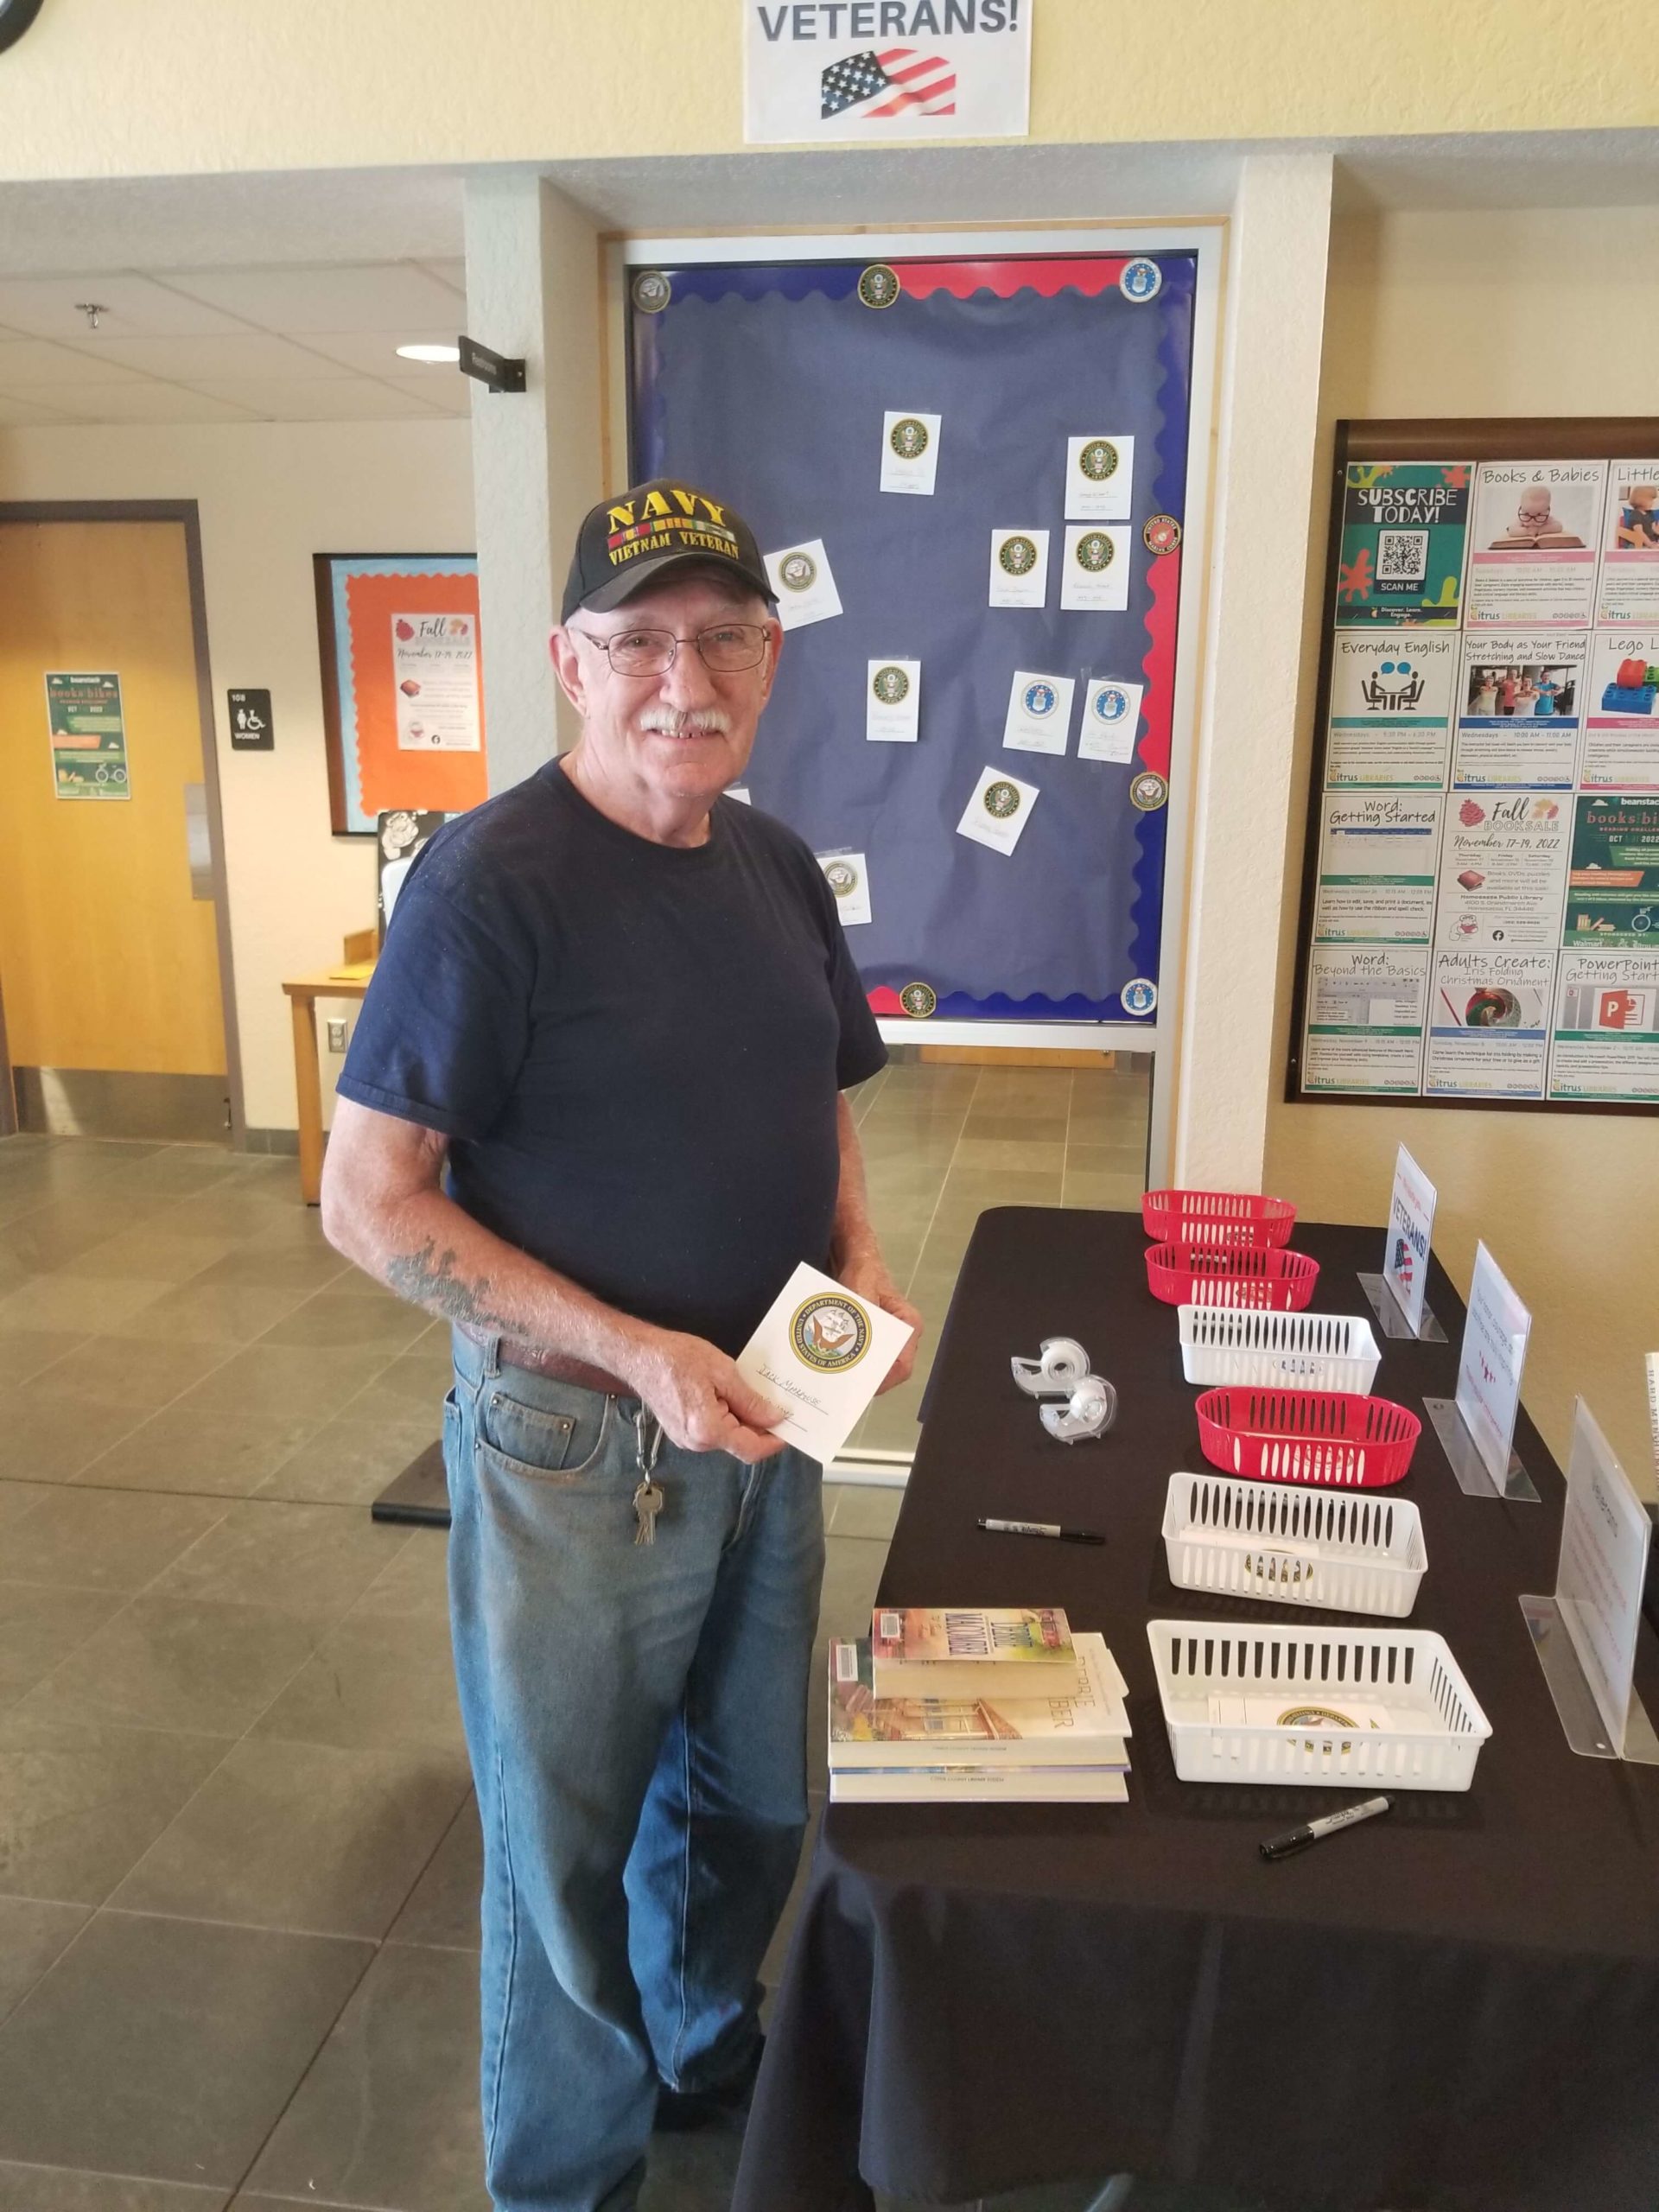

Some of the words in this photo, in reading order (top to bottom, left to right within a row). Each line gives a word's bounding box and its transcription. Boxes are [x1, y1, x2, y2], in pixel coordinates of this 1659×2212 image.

[757, 0, 1018, 41] VETERANS!
[1483, 468, 1527, 484] Books
[1531, 470, 1544, 481] &
[1548, 467, 1599, 482] Babies
[1357, 488, 1458, 506] SUBSCRIBE
[607, 490, 727, 534] NAVY
[1373, 506, 1440, 524] TODAY!
[608, 533, 672, 566] VIETNAM
[679, 531, 739, 560] VETERAN
[1381, 582, 1404, 591] SCAN
[1406, 582, 1419, 591] ME
[1471, 611, 1500, 620] Citrus
[420, 617, 447, 638] Fall
[1341, 640, 1400, 656] Everyday
[1405, 640, 1450, 657] English
[1466, 640, 1487, 649] Your
[1491, 640, 1513, 652] Body
[1531, 640, 1553, 649] Your
[1556, 639, 1586, 649] Friend
[1609, 638, 1644, 656] Lego
[1465, 652, 1514, 664] Stretching
[1516, 652, 1533, 660] and
[1535, 652, 1555, 660] Slow
[1559, 652, 1586, 660] Dance
[1329, 772, 1358, 782] Citrus
[1457, 772, 1486, 782] Citrus
[1583, 772, 1612, 783] Citrus
[1364, 798, 1402, 812] Word:
[1492, 797, 1529, 821] Fall
[1330, 810, 1380, 826] Getting
[1385, 810, 1435, 823] Started
[1586, 811, 1636, 823] books
[1484, 821, 1560, 831] BOOKSALE
[1453, 833, 1503, 849] November
[1506, 838, 1532, 849] 17-19,
[1536, 838, 1560, 849] 2022
[1318, 928, 1345, 937] Citrus
[1352, 952, 1389, 966] Word:
[1438, 953, 1488, 968] Adults
[1495, 955, 1551, 969] Create:
[1313, 964, 1356, 976] Beyond
[1360, 965, 1382, 976] the
[1386, 965, 1426, 976] Basics
[1464, 967, 1485, 976] Iris
[1490, 967, 1523, 978] Folding
[1566, 969, 1617, 984] Getting
[1440, 976, 1493, 985] Christmas
[1497, 977, 1549, 987] Ornament
[1553, 1083, 1581, 1092] Citrus
[1393, 1192, 1427, 1262] VETERANS!
[804, 1299, 849, 1314] DEPARTMENT
[848, 1306, 856, 1314] OF
[855, 1313, 864, 1328] THE
[796, 1319, 804, 1344] UNITED
[856, 1328, 865, 1348] NAVY
[798, 1343, 817, 1363] STATES
[827, 1351, 855, 1367] AMERICA
[1649, 1370, 1657, 1403] HARD
[945, 1613, 988, 1655] MACOMBER
